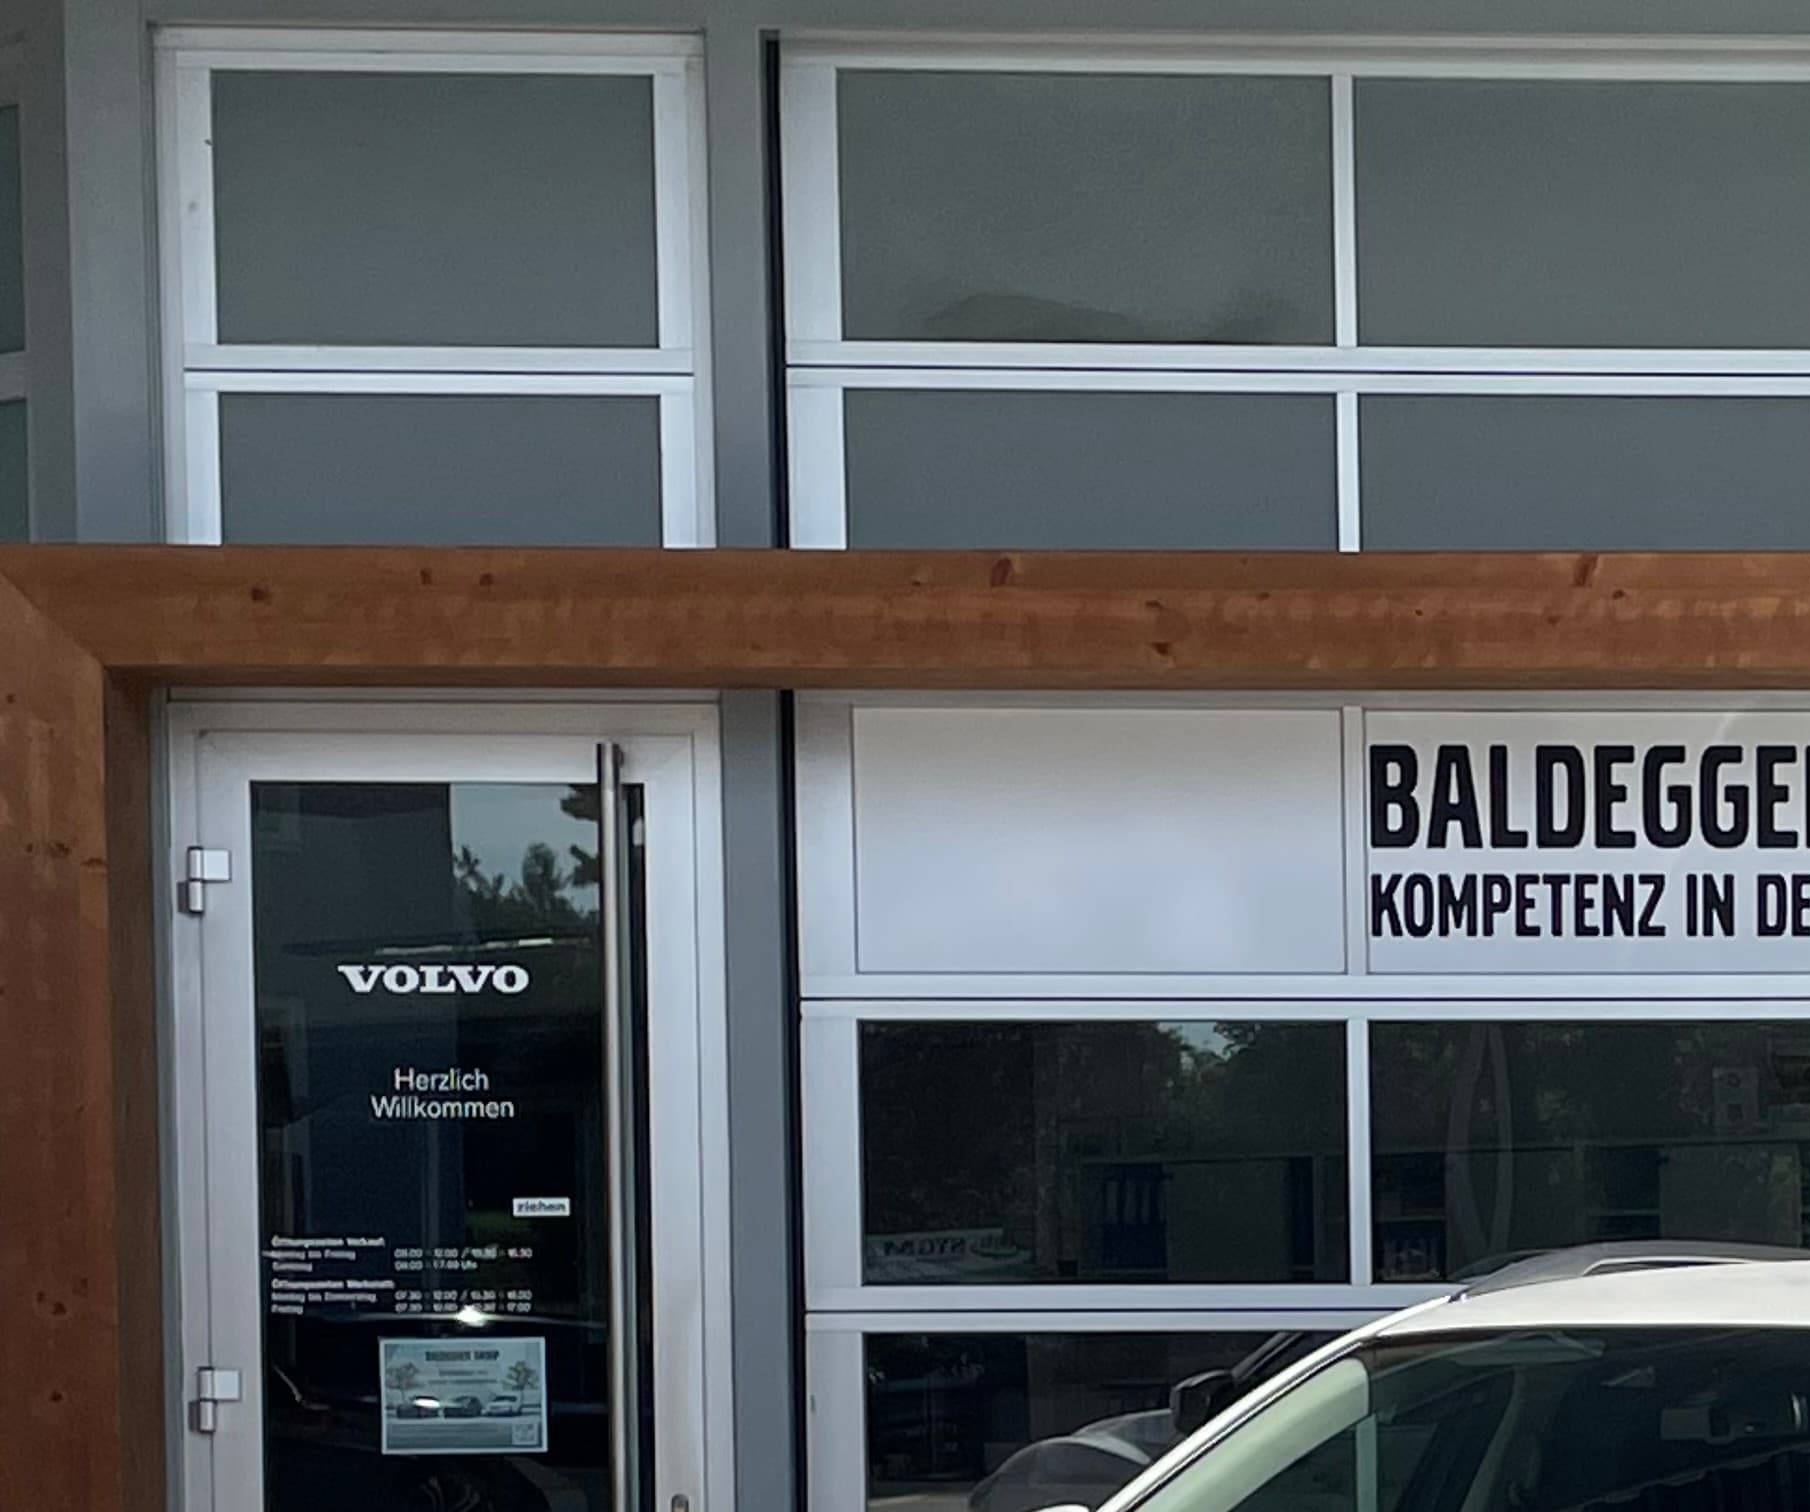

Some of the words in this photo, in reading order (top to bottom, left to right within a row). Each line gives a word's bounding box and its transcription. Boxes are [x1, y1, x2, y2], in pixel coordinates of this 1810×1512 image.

[1370, 873, 1666, 938] KOMPETENZ
[1686, 873, 1735, 937] IN
[337, 965, 530, 993] VOLVO
[394, 1067, 490, 1091] Herzlich
[370, 1095, 515, 1119] Willkommen
